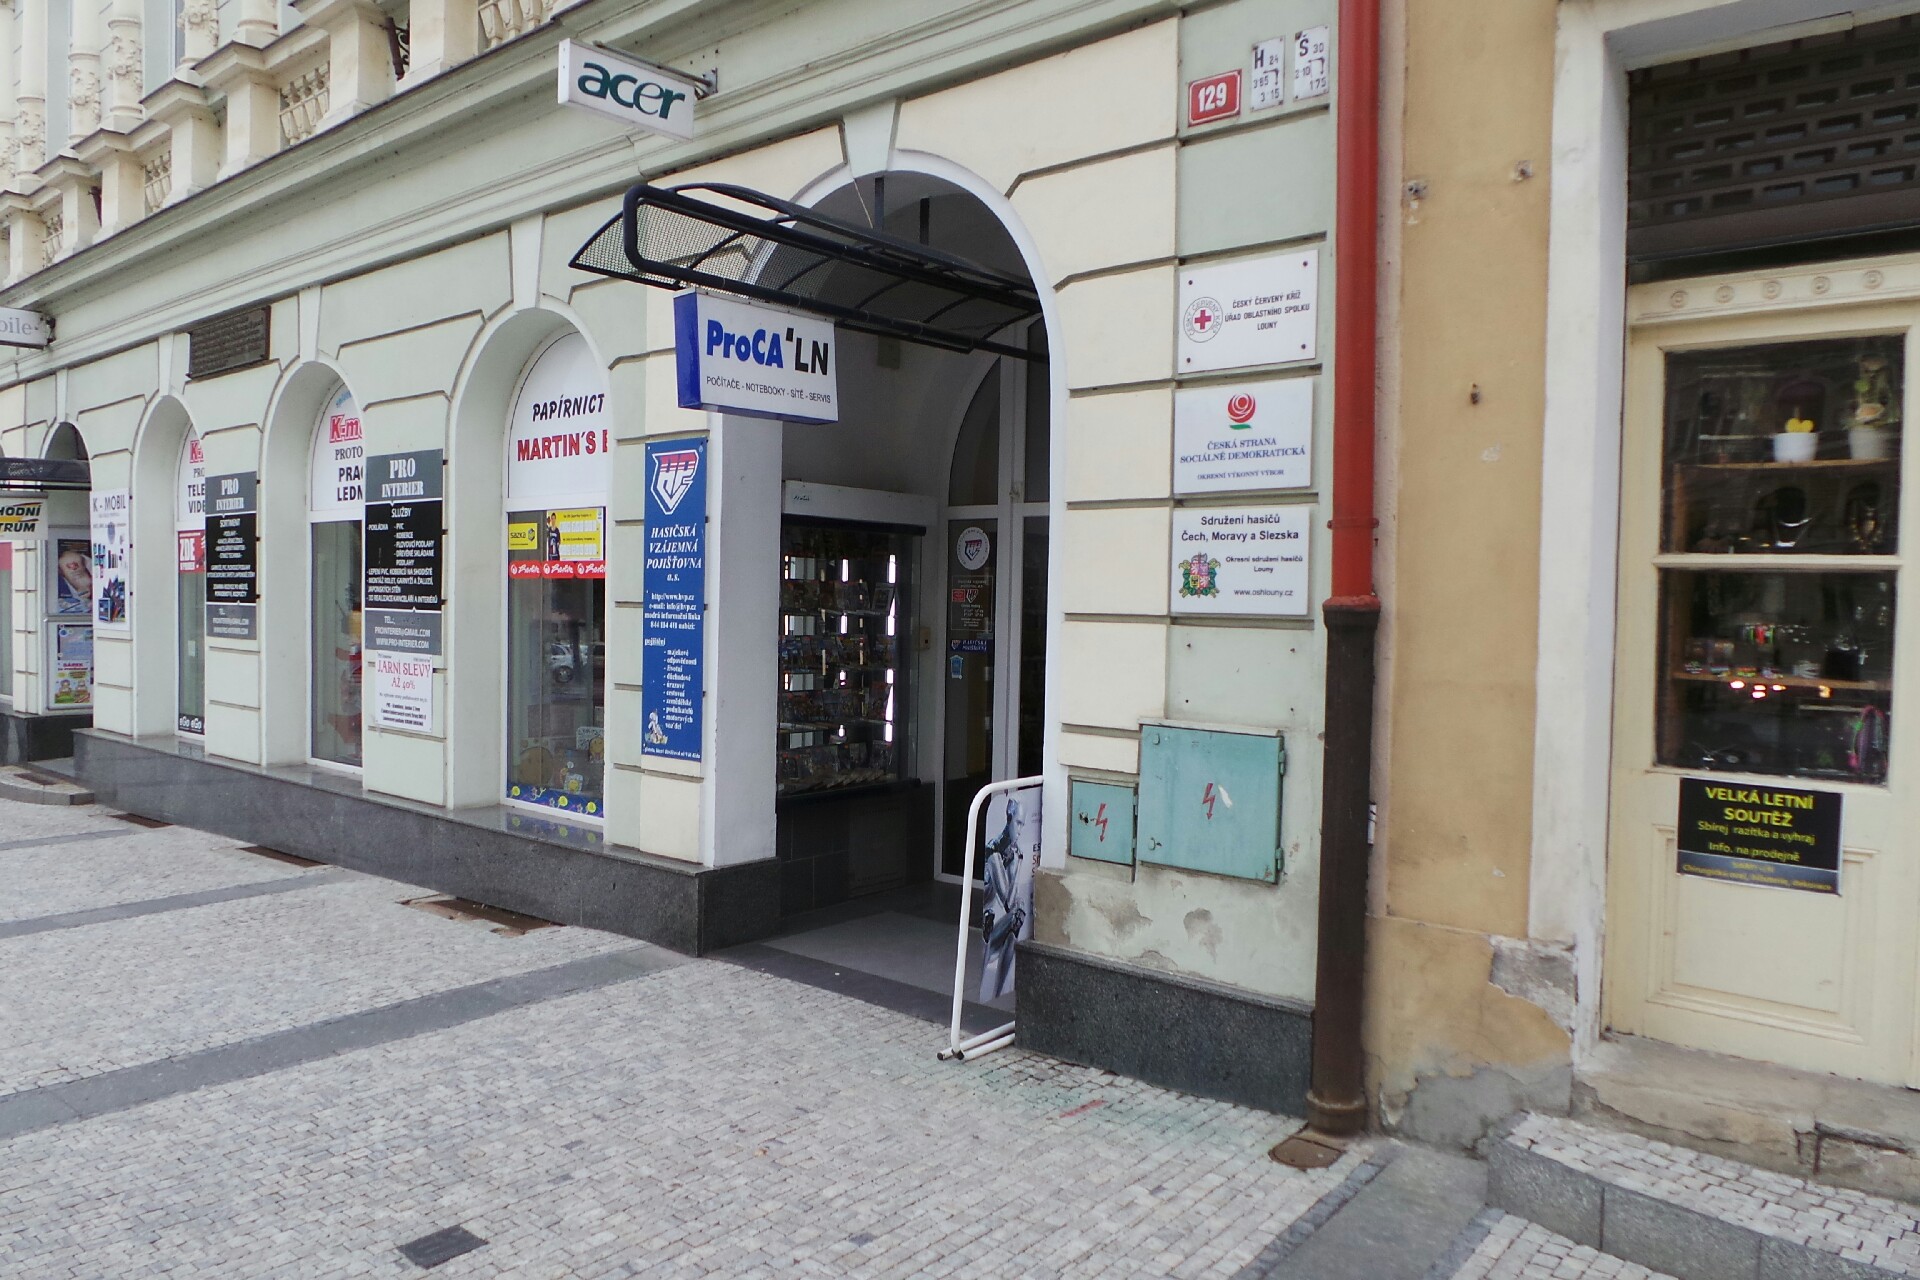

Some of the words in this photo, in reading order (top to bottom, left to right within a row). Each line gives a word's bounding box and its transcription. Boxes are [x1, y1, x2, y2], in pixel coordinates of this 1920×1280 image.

[1254, 49, 1264, 69] H
[577, 62, 685, 119] acer
[1198, 82, 1227, 112] 129
[1232, 298, 1253, 309] ČESKÝ
[1254, 294, 1284, 306] ČERVENÝ
[1244, 306, 1282, 319] OBLASTNÍHO
[1285, 303, 1310, 314] SPOLKU
[1257, 321, 1278, 330] LOUNY
[706, 375, 741, 390] POČÍTAČE
[745, 382, 786, 396] NOTEBOOKY
[809, 392, 831, 404] SERVIS
[1207, 438, 1237, 450] ČESKÁ
[1239, 437, 1277, 449] STRANA
[1228, 445, 1305, 460] DEMOKRATICKÁ
[338, 465, 364, 482] PRA
[389, 457, 416, 479] PRO
[221, 478, 240, 496] PRO
[381, 480, 424, 498] INTERIER
[104, 494, 127, 512] MOBIL
[391, 506, 412, 518] SLUŽBY
[1201, 515, 1244, 526] Sdružení
[1247, 513, 1281, 525] hasičů
[651, 523, 697, 539] HASIČSKÁ
[1181, 530, 1209, 542] Čech,
[1211, 531, 1248, 543] Moravy
[1259, 530, 1299, 541] Slezska
[180, 537, 196, 561] ZDE
[649, 538, 699, 554] VZÁJEMNÁ
[646, 555, 702, 569] POJIŠŤOVNA
[1705, 786, 1761, 804] VELKÁ
[1763, 791, 1814, 810] LETNÍ
[1724, 807, 1793, 828] SOUTĚŽ
[1698, 820, 1729, 836] Sbírej
[1733, 825, 1770, 839] razítka
[1773, 831, 1779, 839] a
[1782, 831, 1816, 846] vyhraj
[1708, 841, 1733, 853] Info.
[1736, 847, 1749, 856] na
[1752, 848, 1800, 863] prodejně
